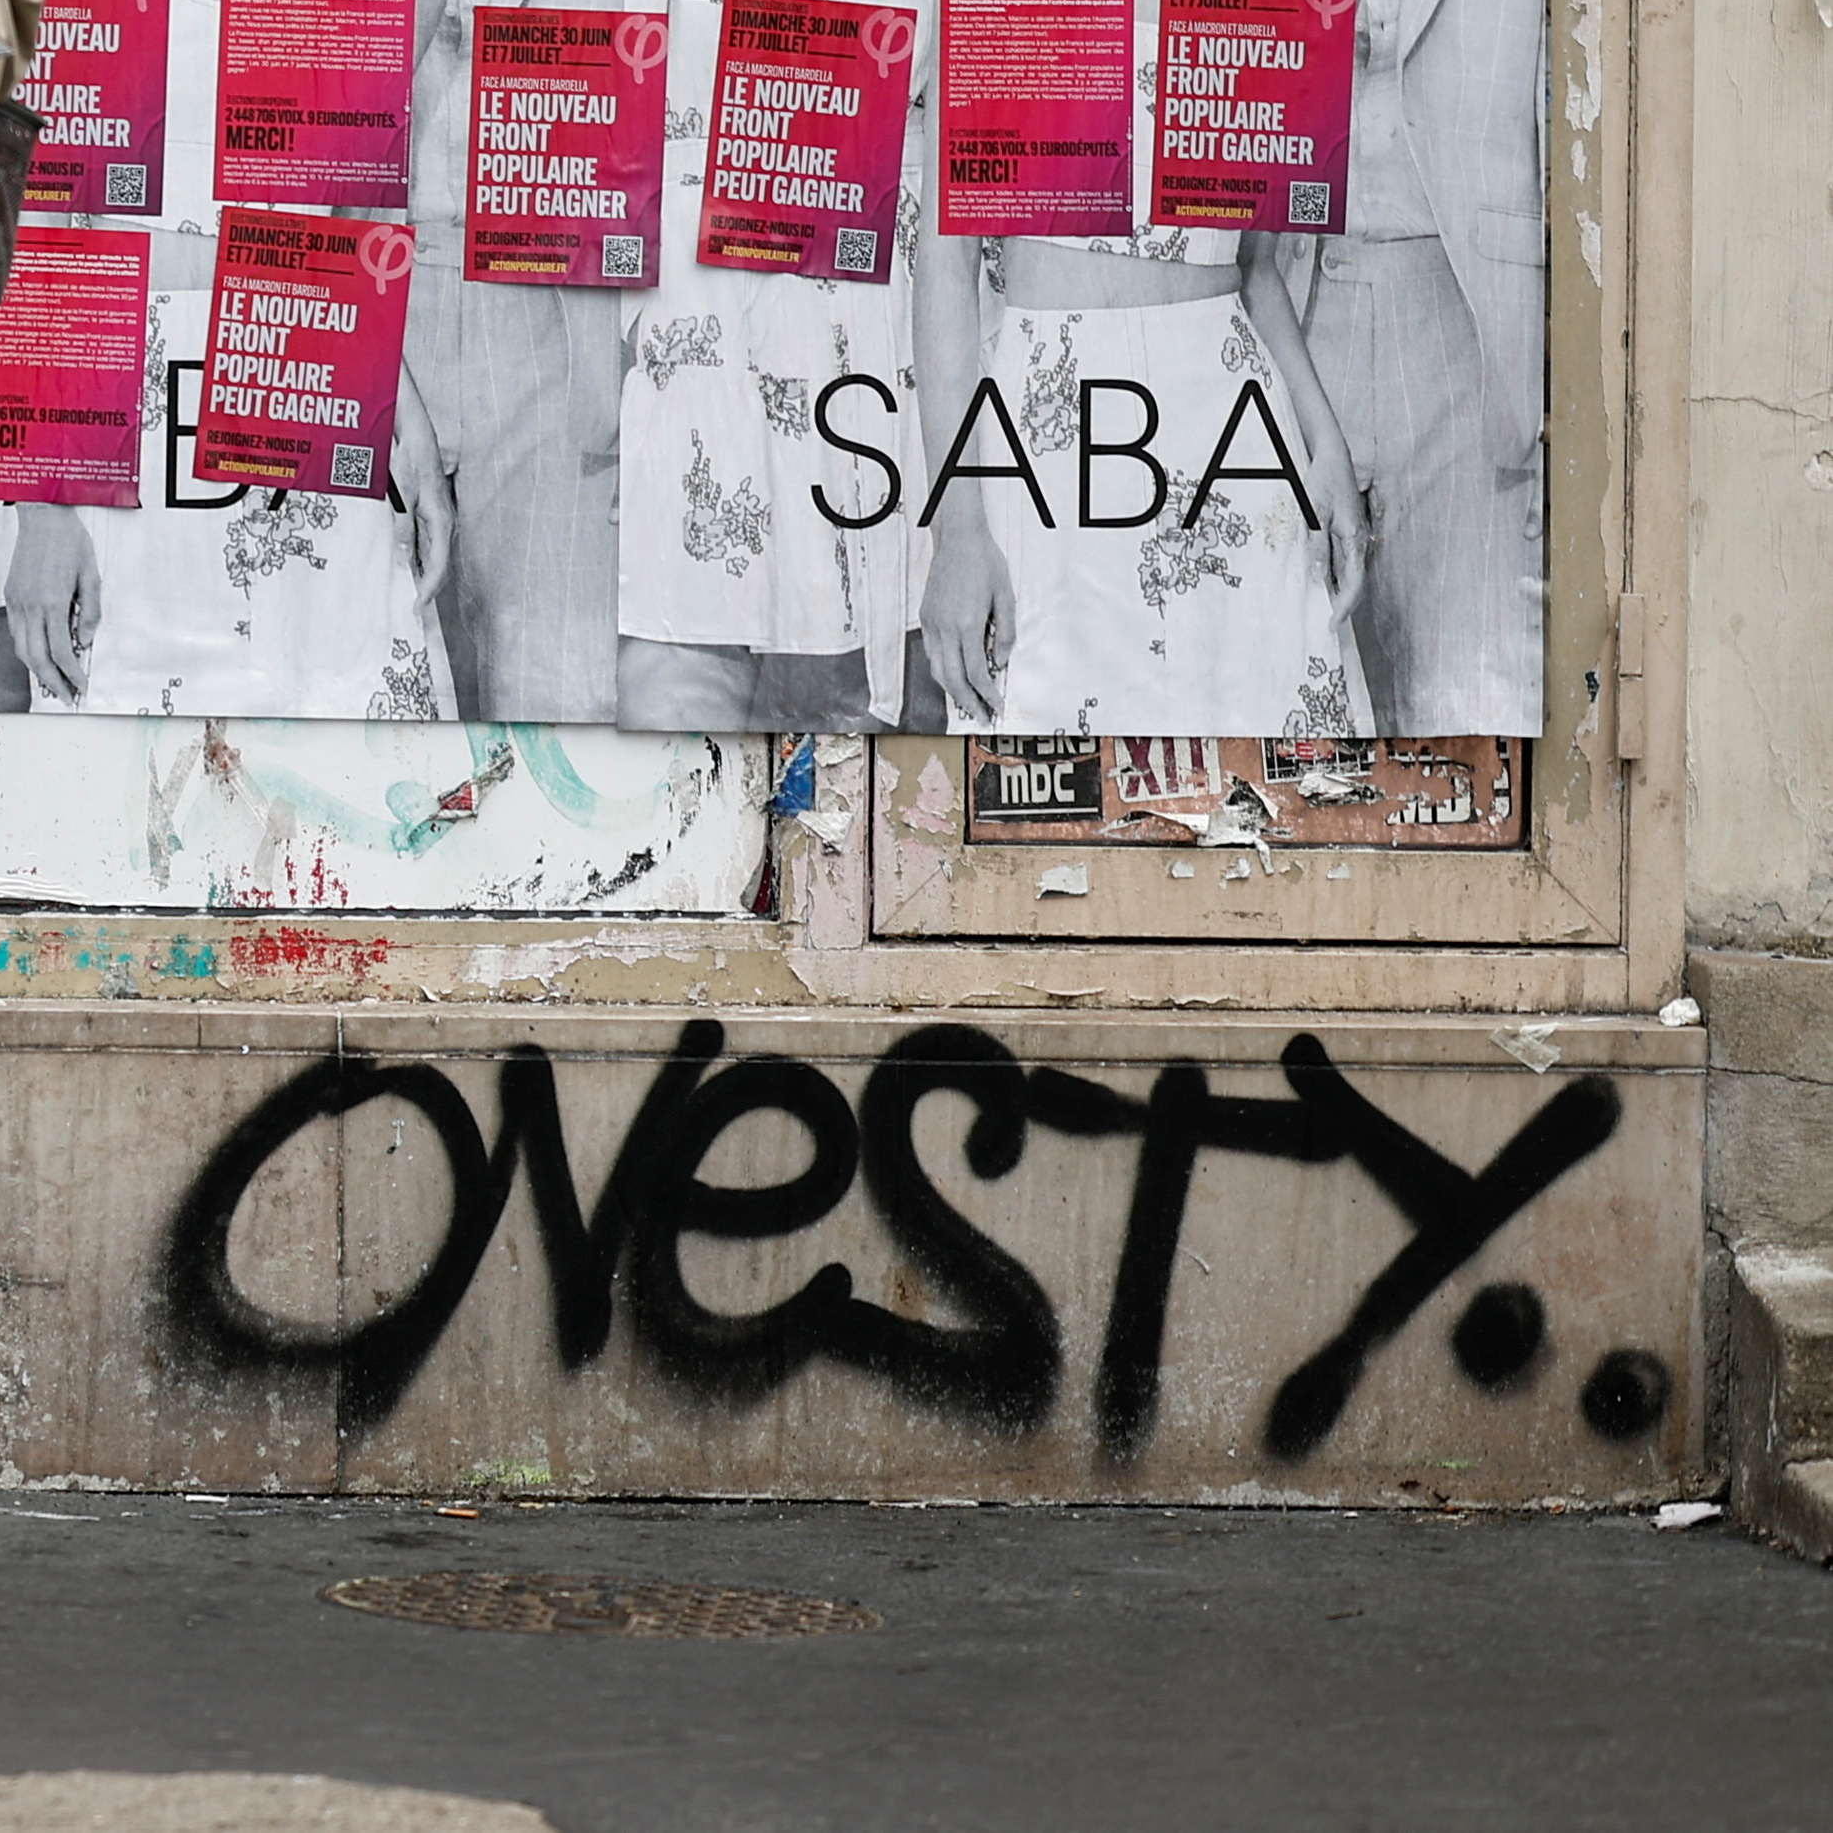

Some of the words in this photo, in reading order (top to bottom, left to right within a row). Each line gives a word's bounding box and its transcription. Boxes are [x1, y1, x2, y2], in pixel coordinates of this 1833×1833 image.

[219, 291, 246, 320] LE
[251, 295, 358, 333] NOUVEAU
[216, 321, 291, 355] FRONT
[213, 352, 334, 393] POPULAIRE
[209, 384, 266, 417] PEUT
[268, 390, 360, 429] GAGNER
[811, 374, 1322, 530] SABA
